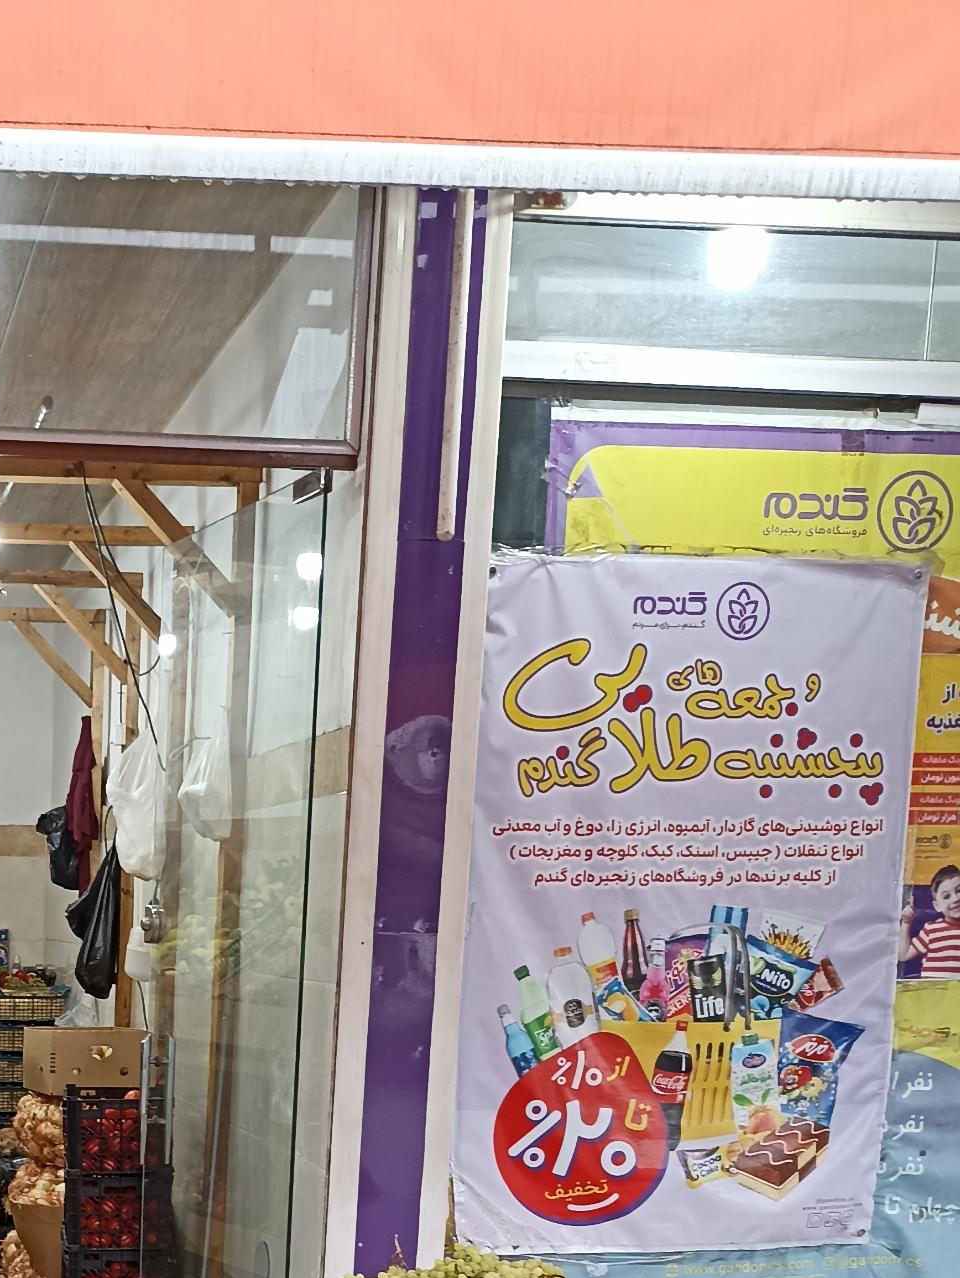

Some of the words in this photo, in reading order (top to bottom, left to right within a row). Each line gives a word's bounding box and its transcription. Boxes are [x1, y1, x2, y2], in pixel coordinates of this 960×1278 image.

[633, 591, 708, 615] گندم
[666, 658, 723, 692] های
[685, 673, 799, 719] جمعه
[804, 673, 822, 702] و
[517, 726, 608, 798] گندم
[713, 727, 884, 806] پنجشنبه
[492, 818, 541, 837] معدنی
[574, 817, 604, 837] دوغ
[625, 819, 661, 837] انرژی
[850, 819, 884, 837] انواع
[584, 849, 593, 862] و
[596, 844, 639, 862] کلوچه
[783, 844, 829, 858] تنقلات
[830, 844, 865, 862] انواع
[534, 867, 569, 887] گندم
[726, 873, 742, 887] در
[745, 869, 791, 887] برندها
[792, 869, 823, 886] کلیه
[824, 869, 837, 886] از
[606, 1056, 631, 1082] از
[901, 1071, 933, 1099] نفر
[624, 1098, 652, 1131] تا
[891, 1114, 925, 1141] نفر
[889, 1156, 925, 1182] نفر
[545, 1179, 609, 1202] تخفیف
